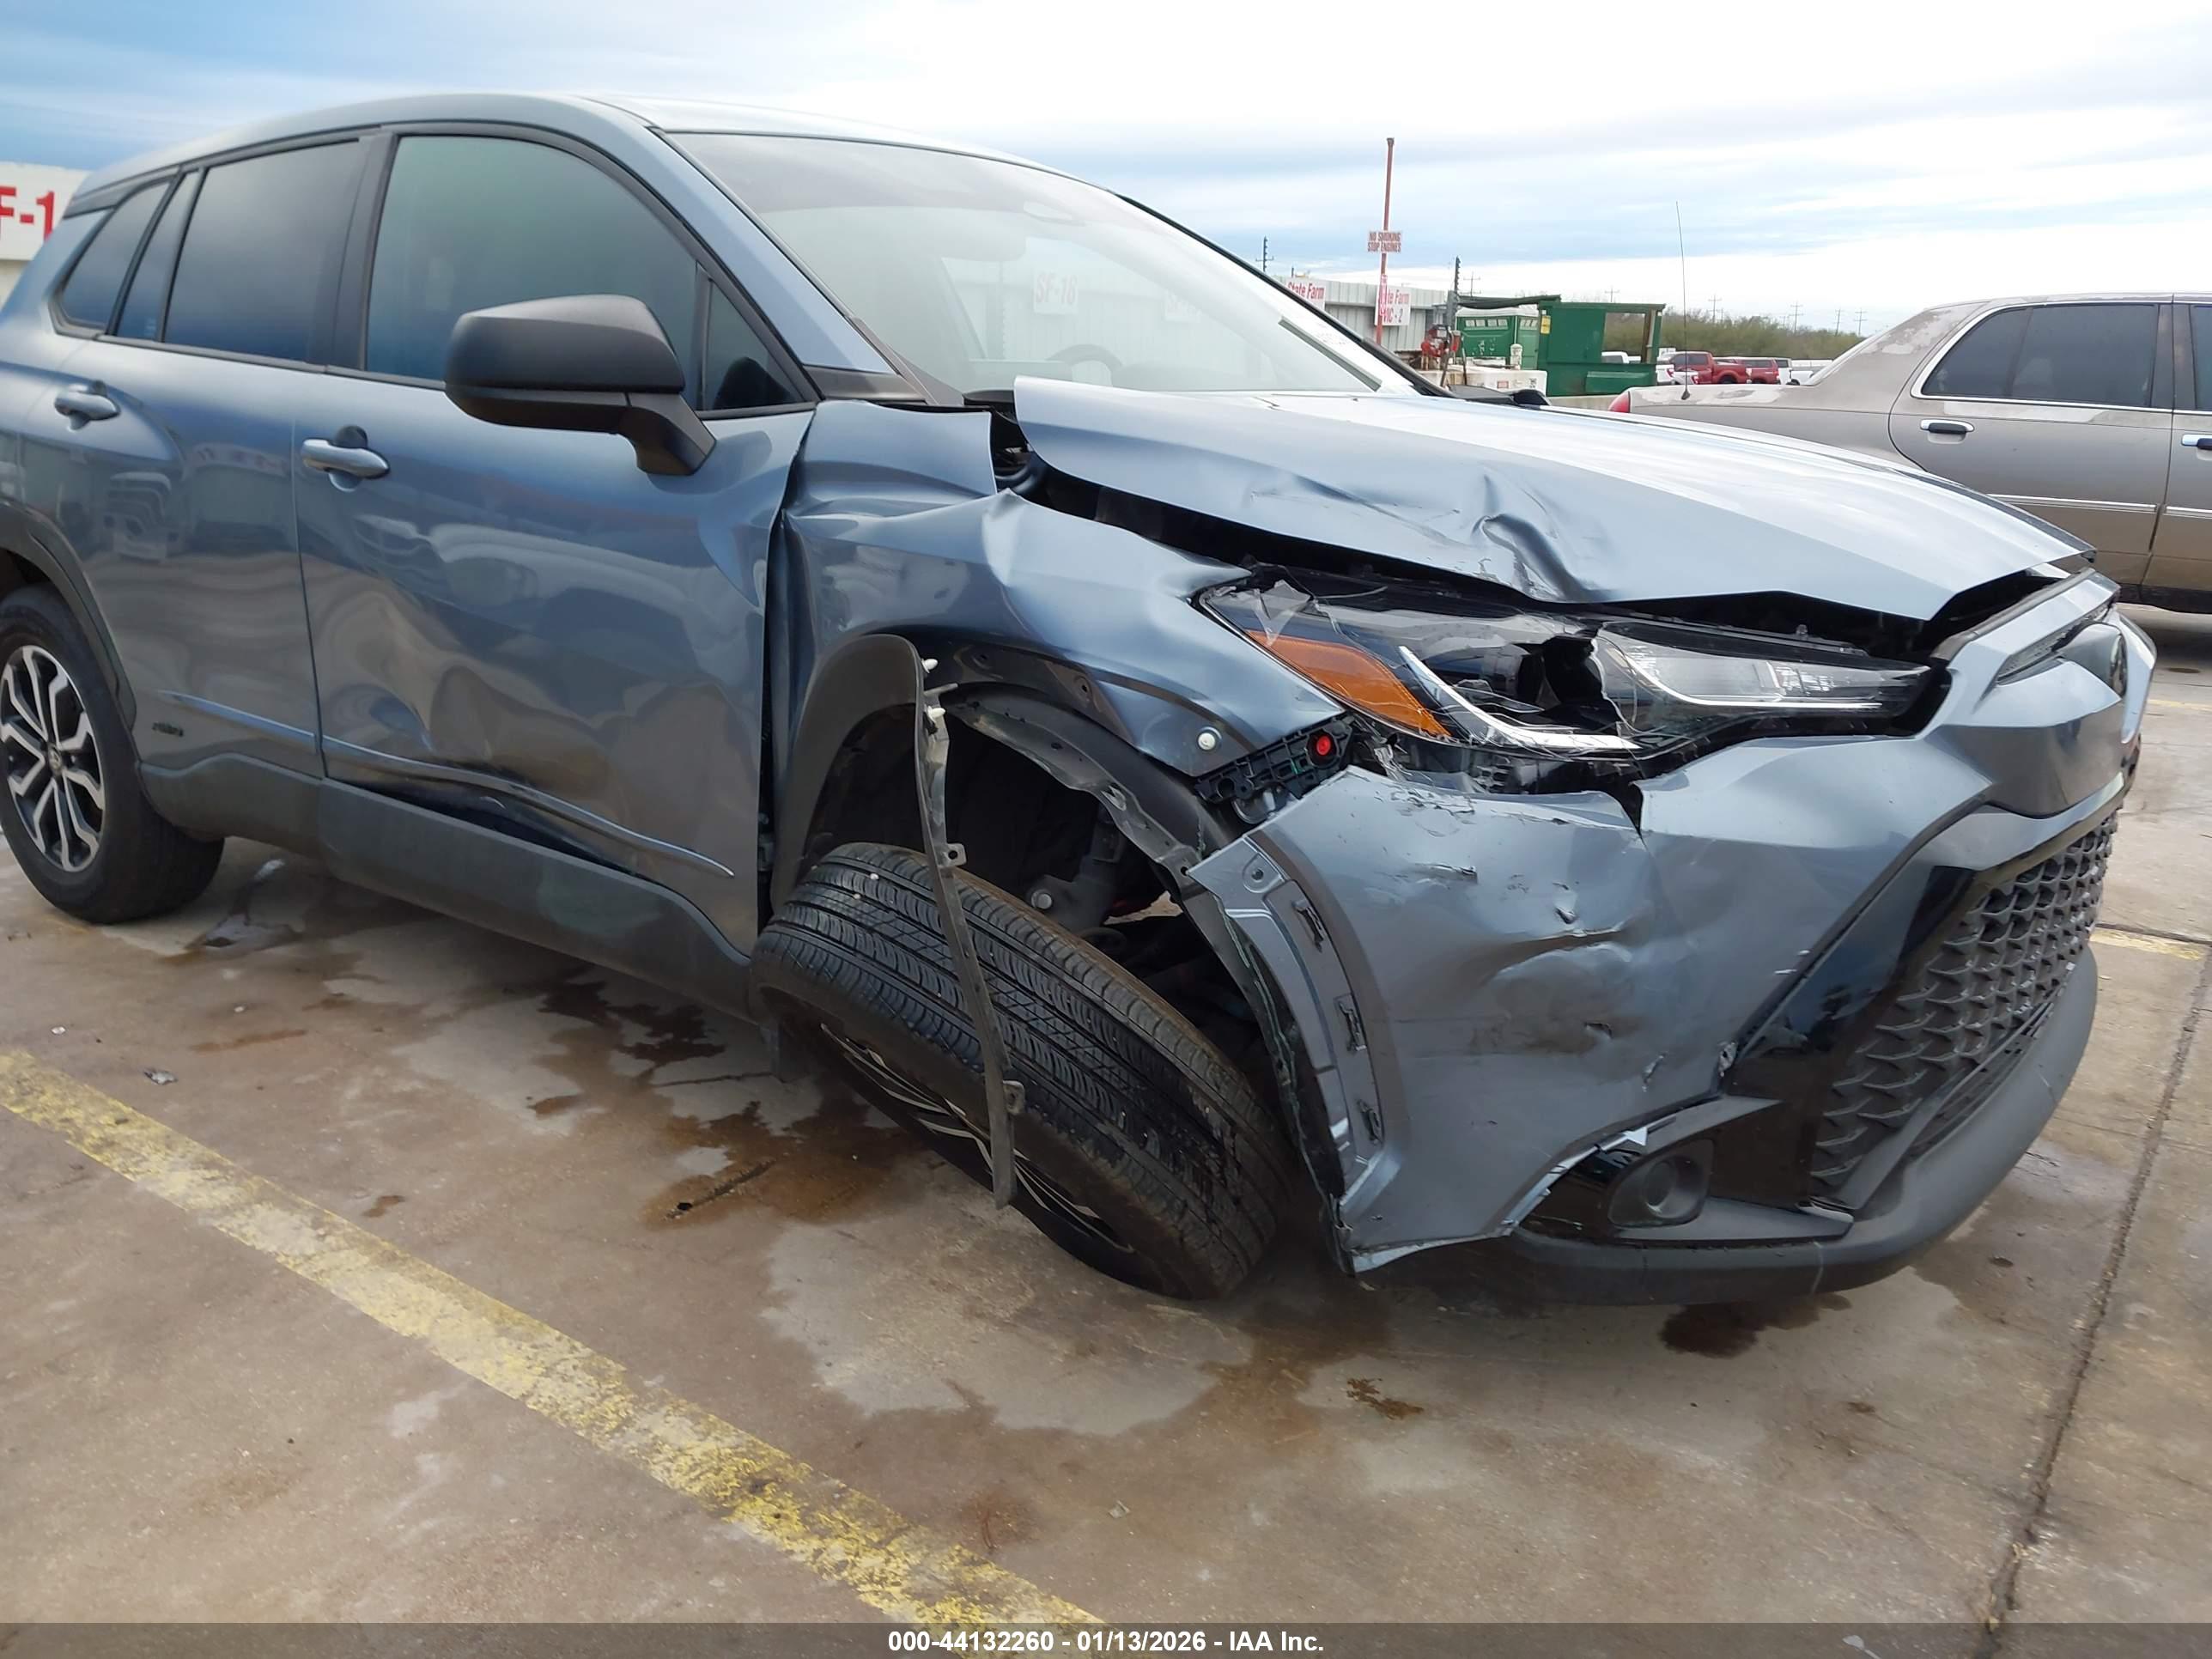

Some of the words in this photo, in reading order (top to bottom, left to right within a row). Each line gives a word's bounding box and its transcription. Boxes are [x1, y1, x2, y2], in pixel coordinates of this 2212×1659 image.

[1369, 232, 1376, 241] NO
[1378, 232, 1401, 241] SMOKING
[1367, 242, 1380, 252] STOP
[1381, 242, 1401, 252] ENGINES
[1307, 283, 1324, 299] Farm
[1395, 289, 1409, 304] Farm
